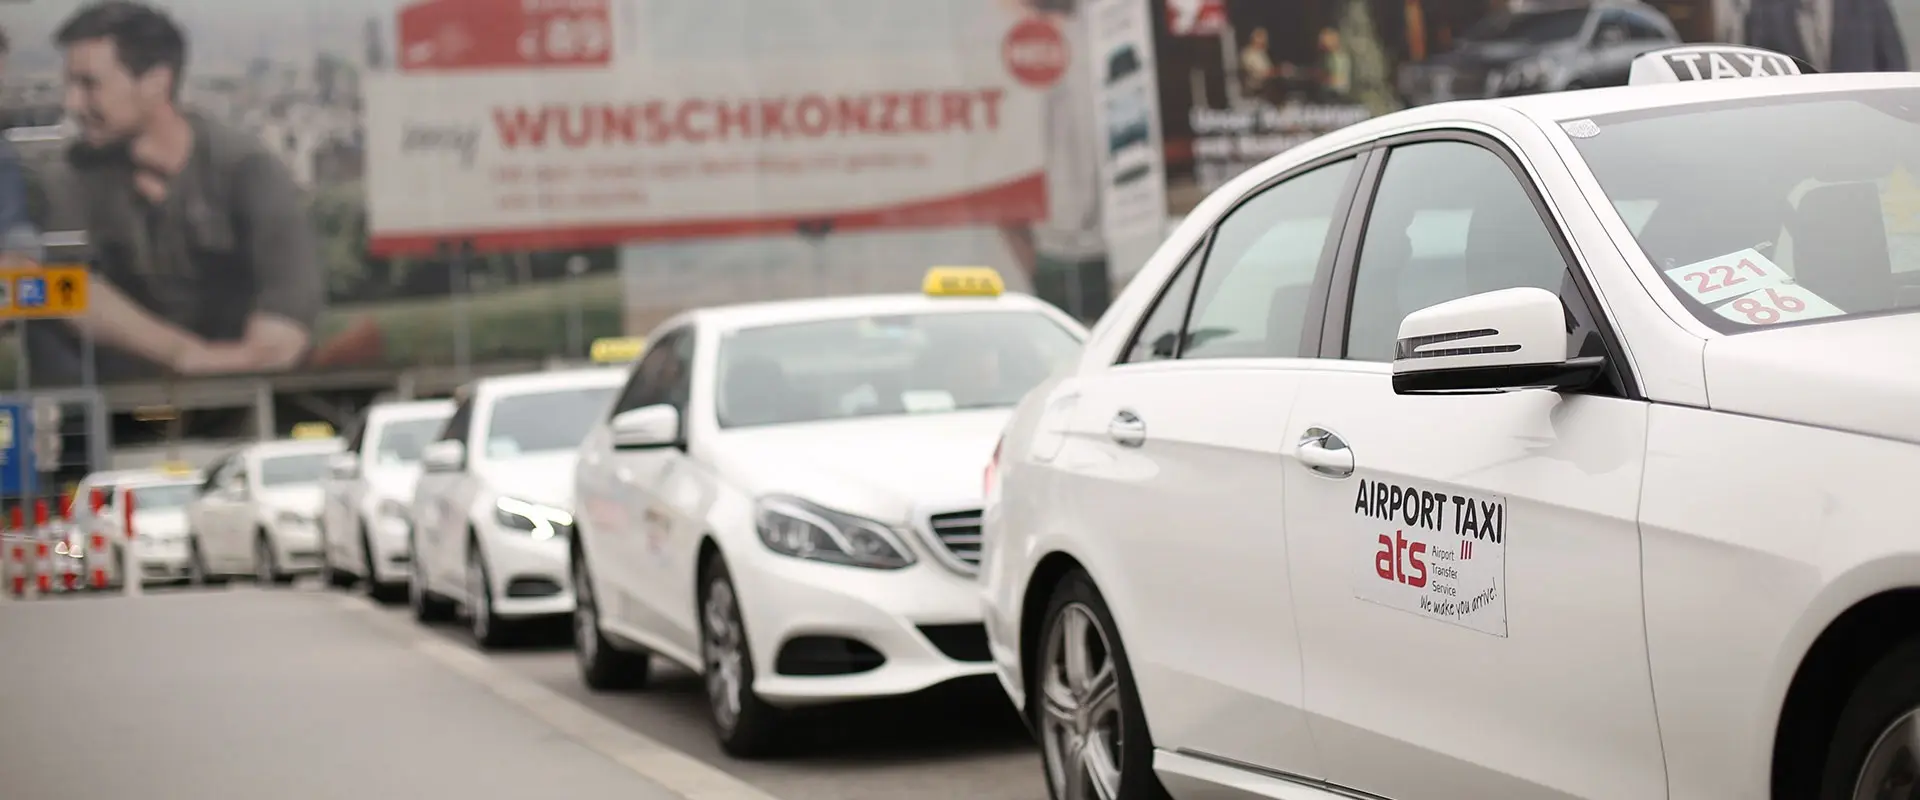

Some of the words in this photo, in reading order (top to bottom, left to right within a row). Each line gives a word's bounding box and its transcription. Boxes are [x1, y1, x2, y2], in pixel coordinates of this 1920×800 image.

[1671, 50, 1787, 81] TAXI
[491, 88, 1003, 149] WUNSCHKONZERT
[1683, 258, 1767, 294] 221
[1732, 288, 1806, 324] 86
[1355, 479, 1447, 531] AIRPORT
[1452, 495, 1503, 544] TAXI
[1375, 529, 1427, 588] ats
[1431, 545, 1455, 561] Airport
[1431, 562, 1458, 580] Transfer
[1420, 594, 1432, 612] We
[1433, 599, 1455, 616] make
[1456, 600, 1470, 620] you
[1471, 576, 1498, 612] arrive!
[1431, 580, 1457, 597] Service
